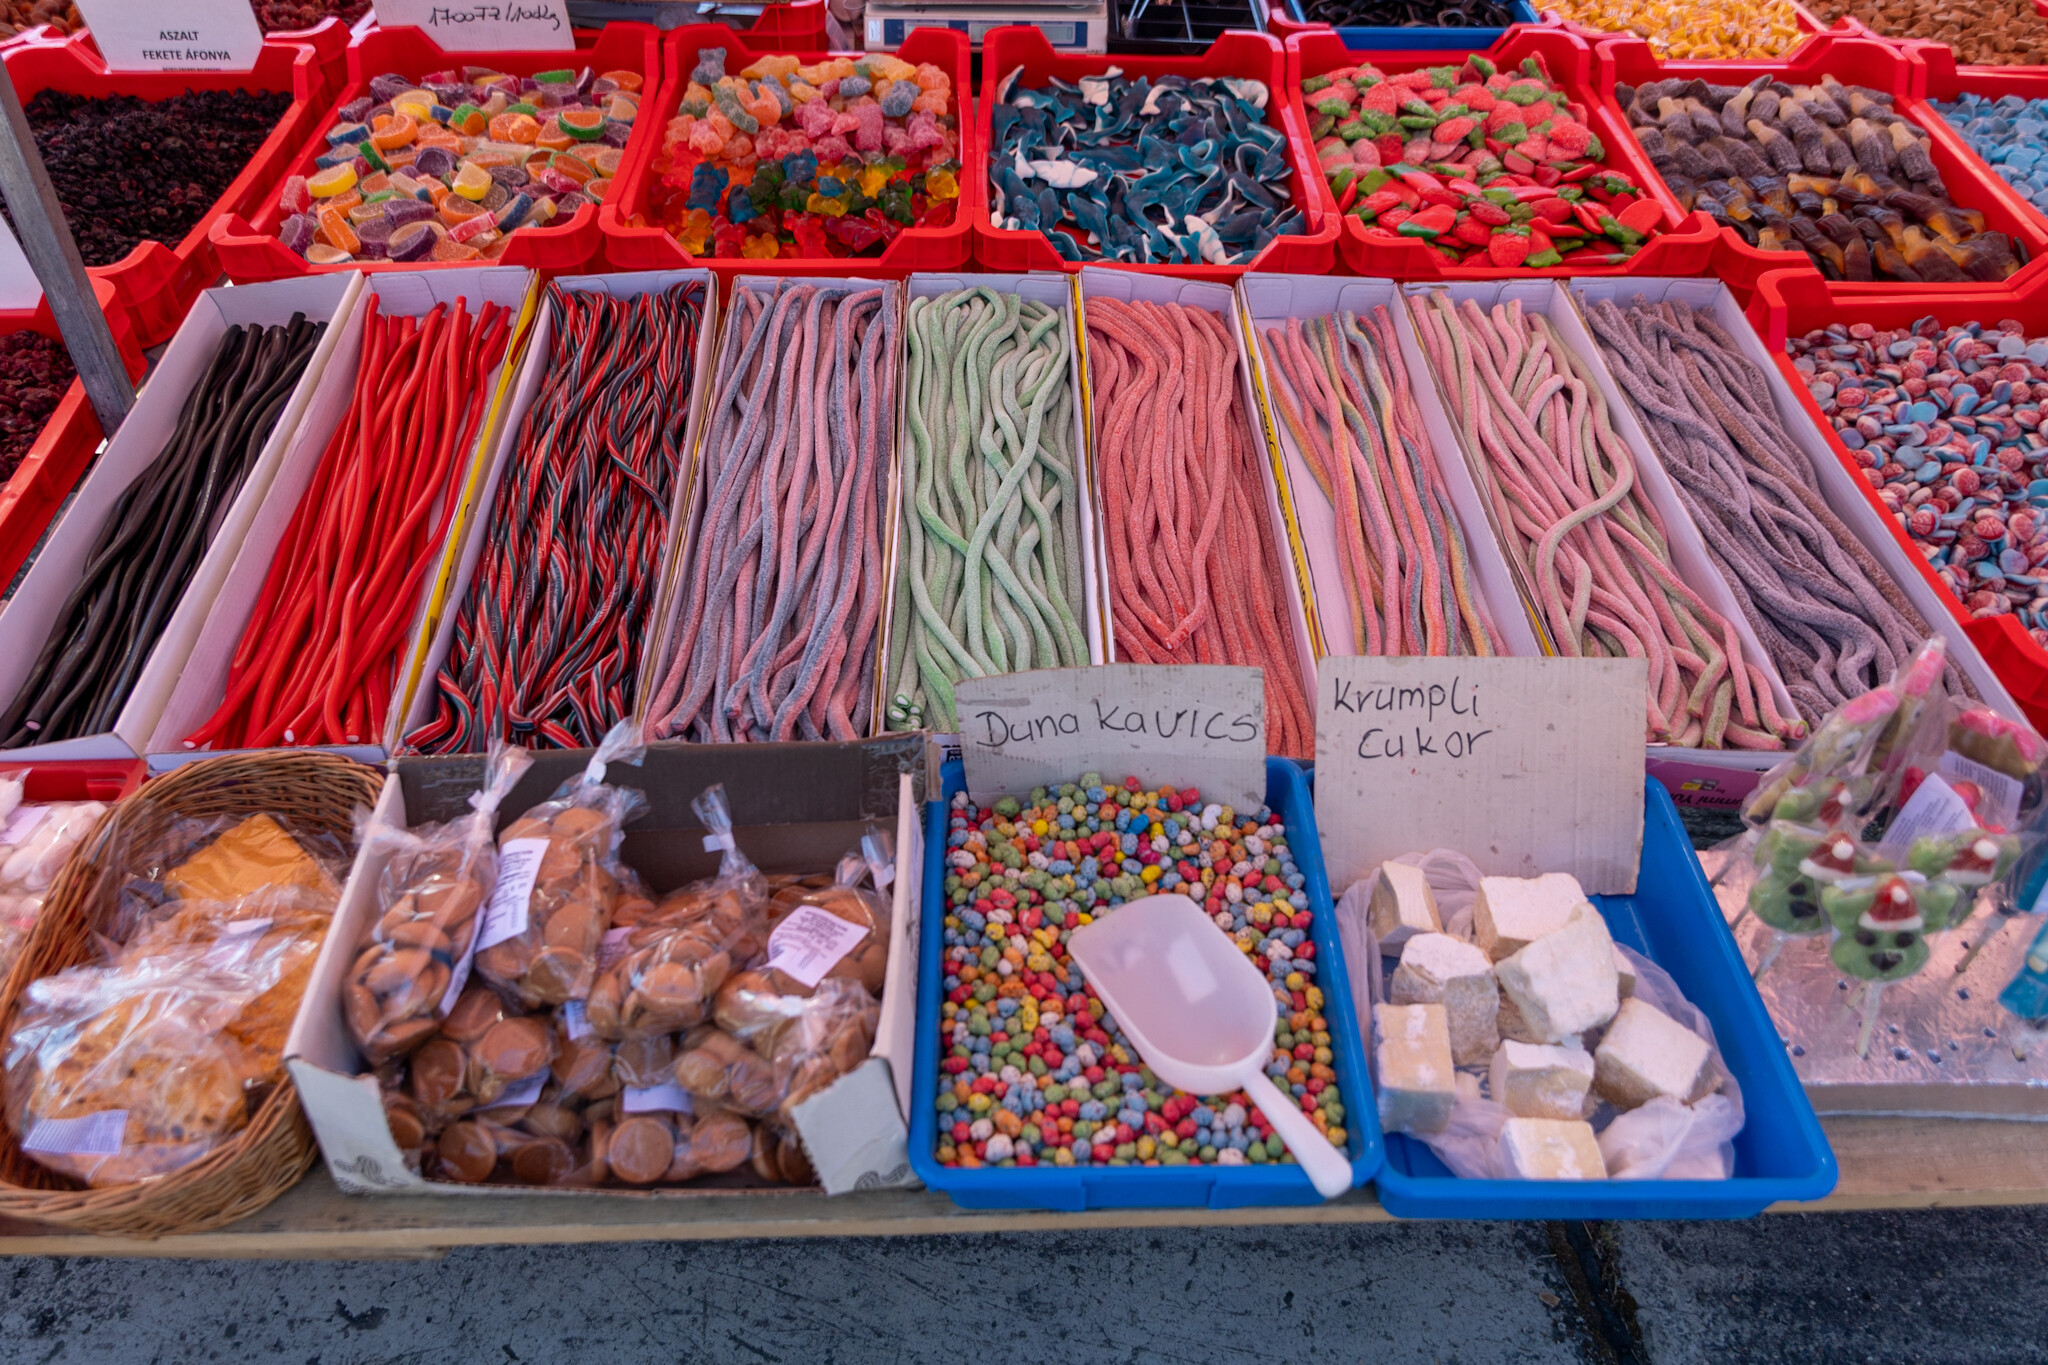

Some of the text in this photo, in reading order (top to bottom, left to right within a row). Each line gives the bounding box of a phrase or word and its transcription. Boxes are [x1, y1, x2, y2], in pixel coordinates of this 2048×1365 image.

[160, 31, 199, 41] ASZALT
[142, 48, 231, 61] FEKETE ÁFONYA
[1334, 676, 1479, 722] Krumpli
[975, 711, 1081, 747] Duna
[1695, 795, 1744, 806] ummi
